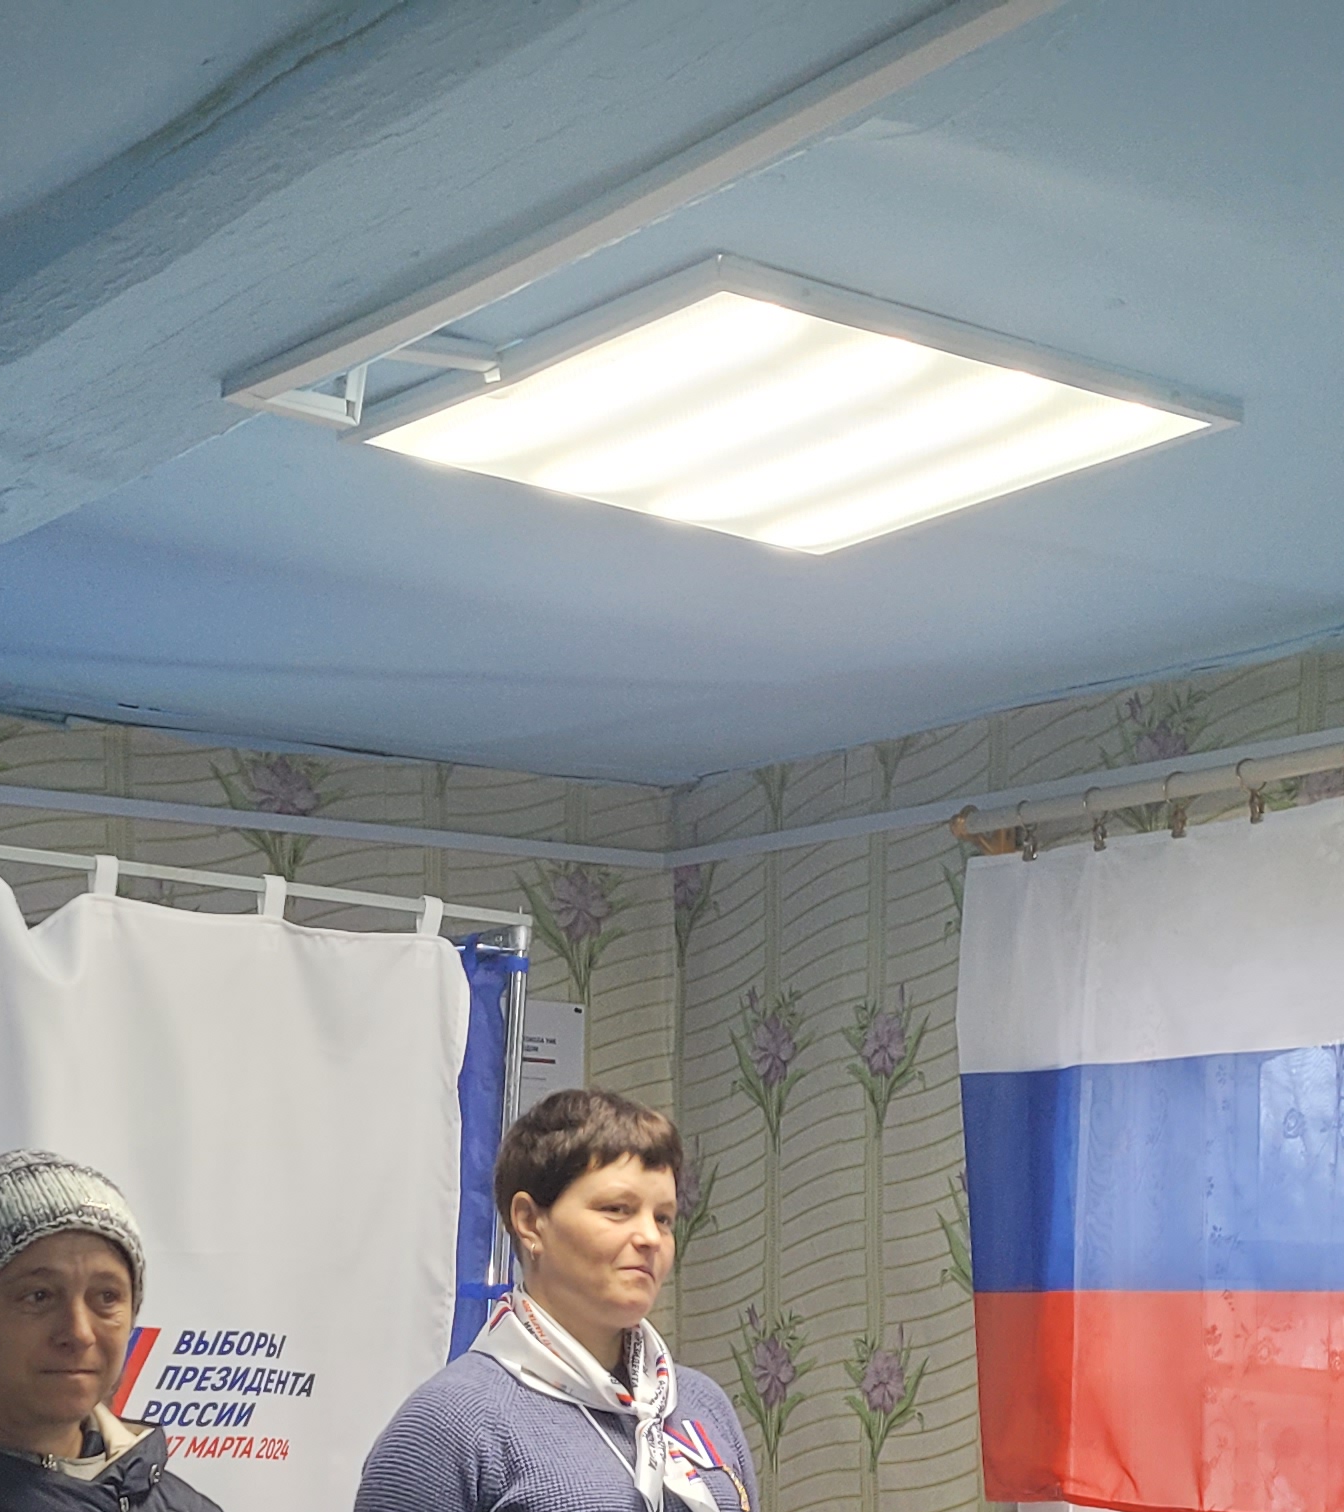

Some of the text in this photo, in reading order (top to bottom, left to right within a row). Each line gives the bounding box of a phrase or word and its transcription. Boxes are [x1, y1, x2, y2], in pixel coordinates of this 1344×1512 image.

[172, 1330, 287, 1359] ВЫБОРЫ
[155, 1365, 316, 1397] ПРЕЗИДЕНТА
[142, 1400, 256, 1427] РОССИИ
[183, 1436, 253, 1459] МАРТА
[255, 1439, 290, 1461] 2024
